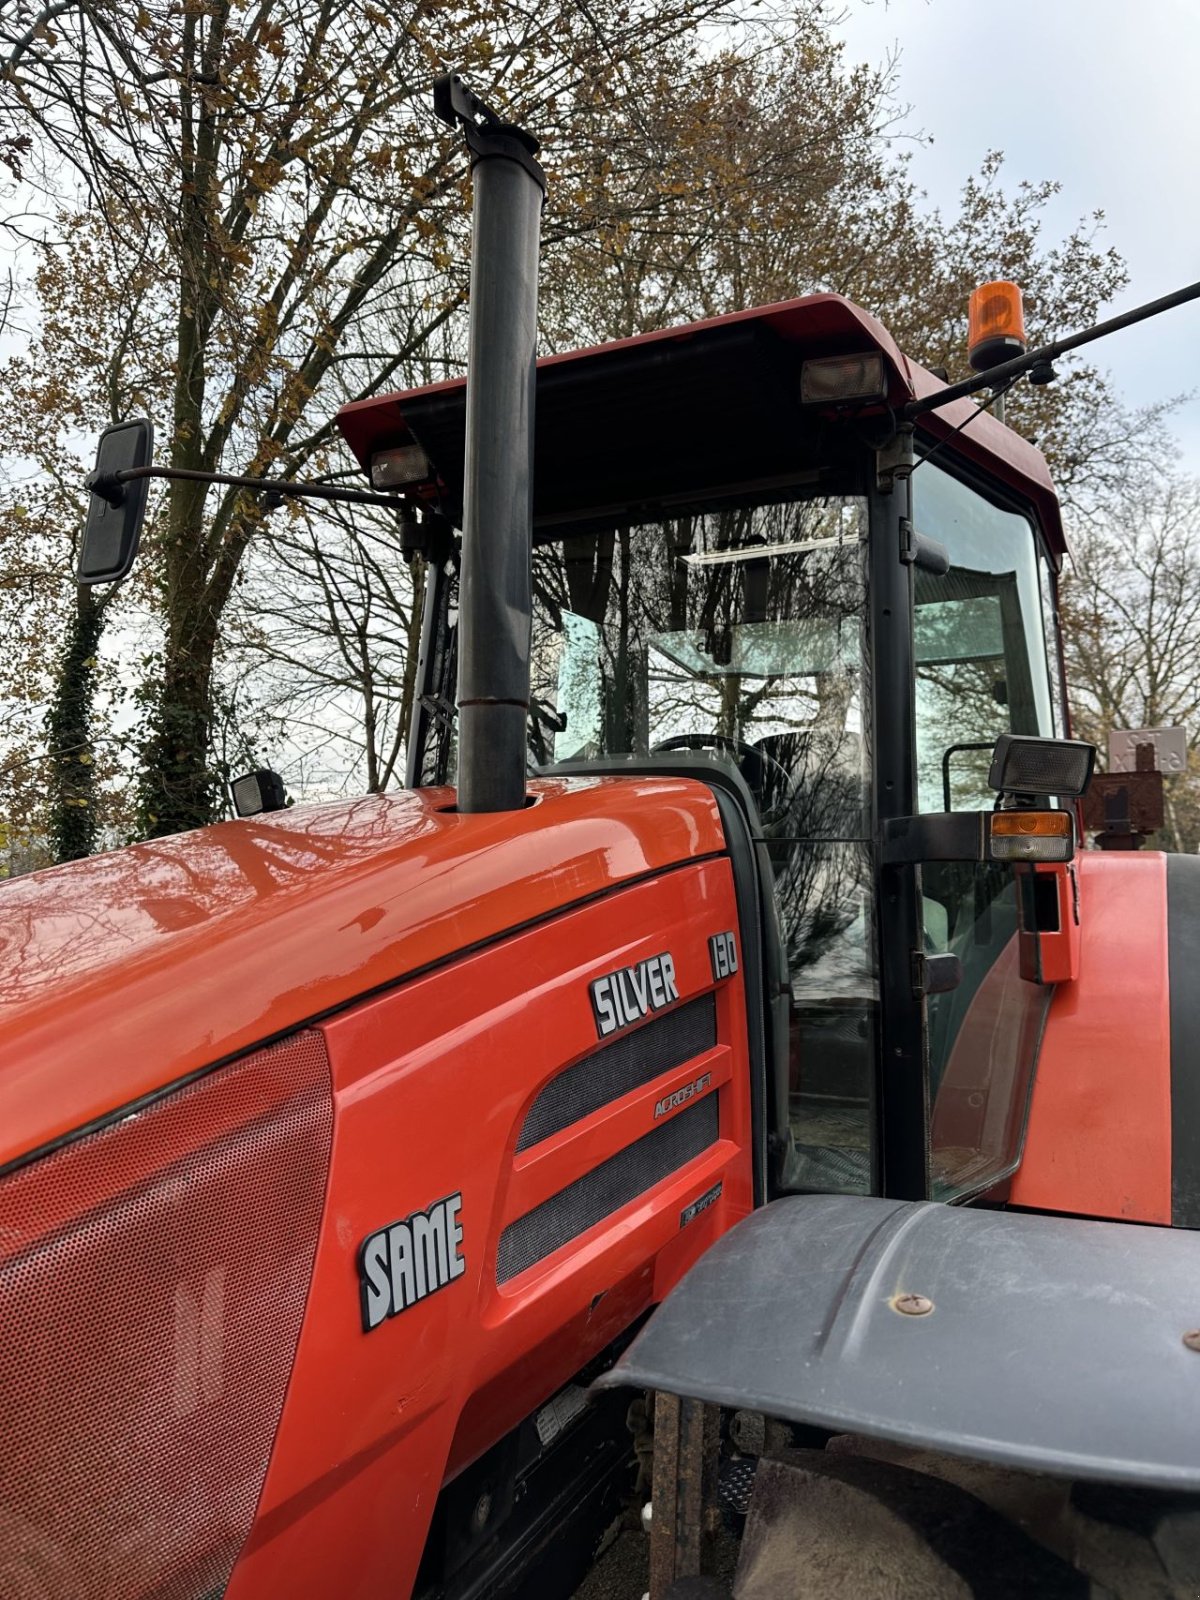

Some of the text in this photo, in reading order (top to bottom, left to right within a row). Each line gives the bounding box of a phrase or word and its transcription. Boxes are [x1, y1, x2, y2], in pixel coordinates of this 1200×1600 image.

[592, 931, 739, 1036] SILVER 130
[362, 1192, 466, 1331] SAME
